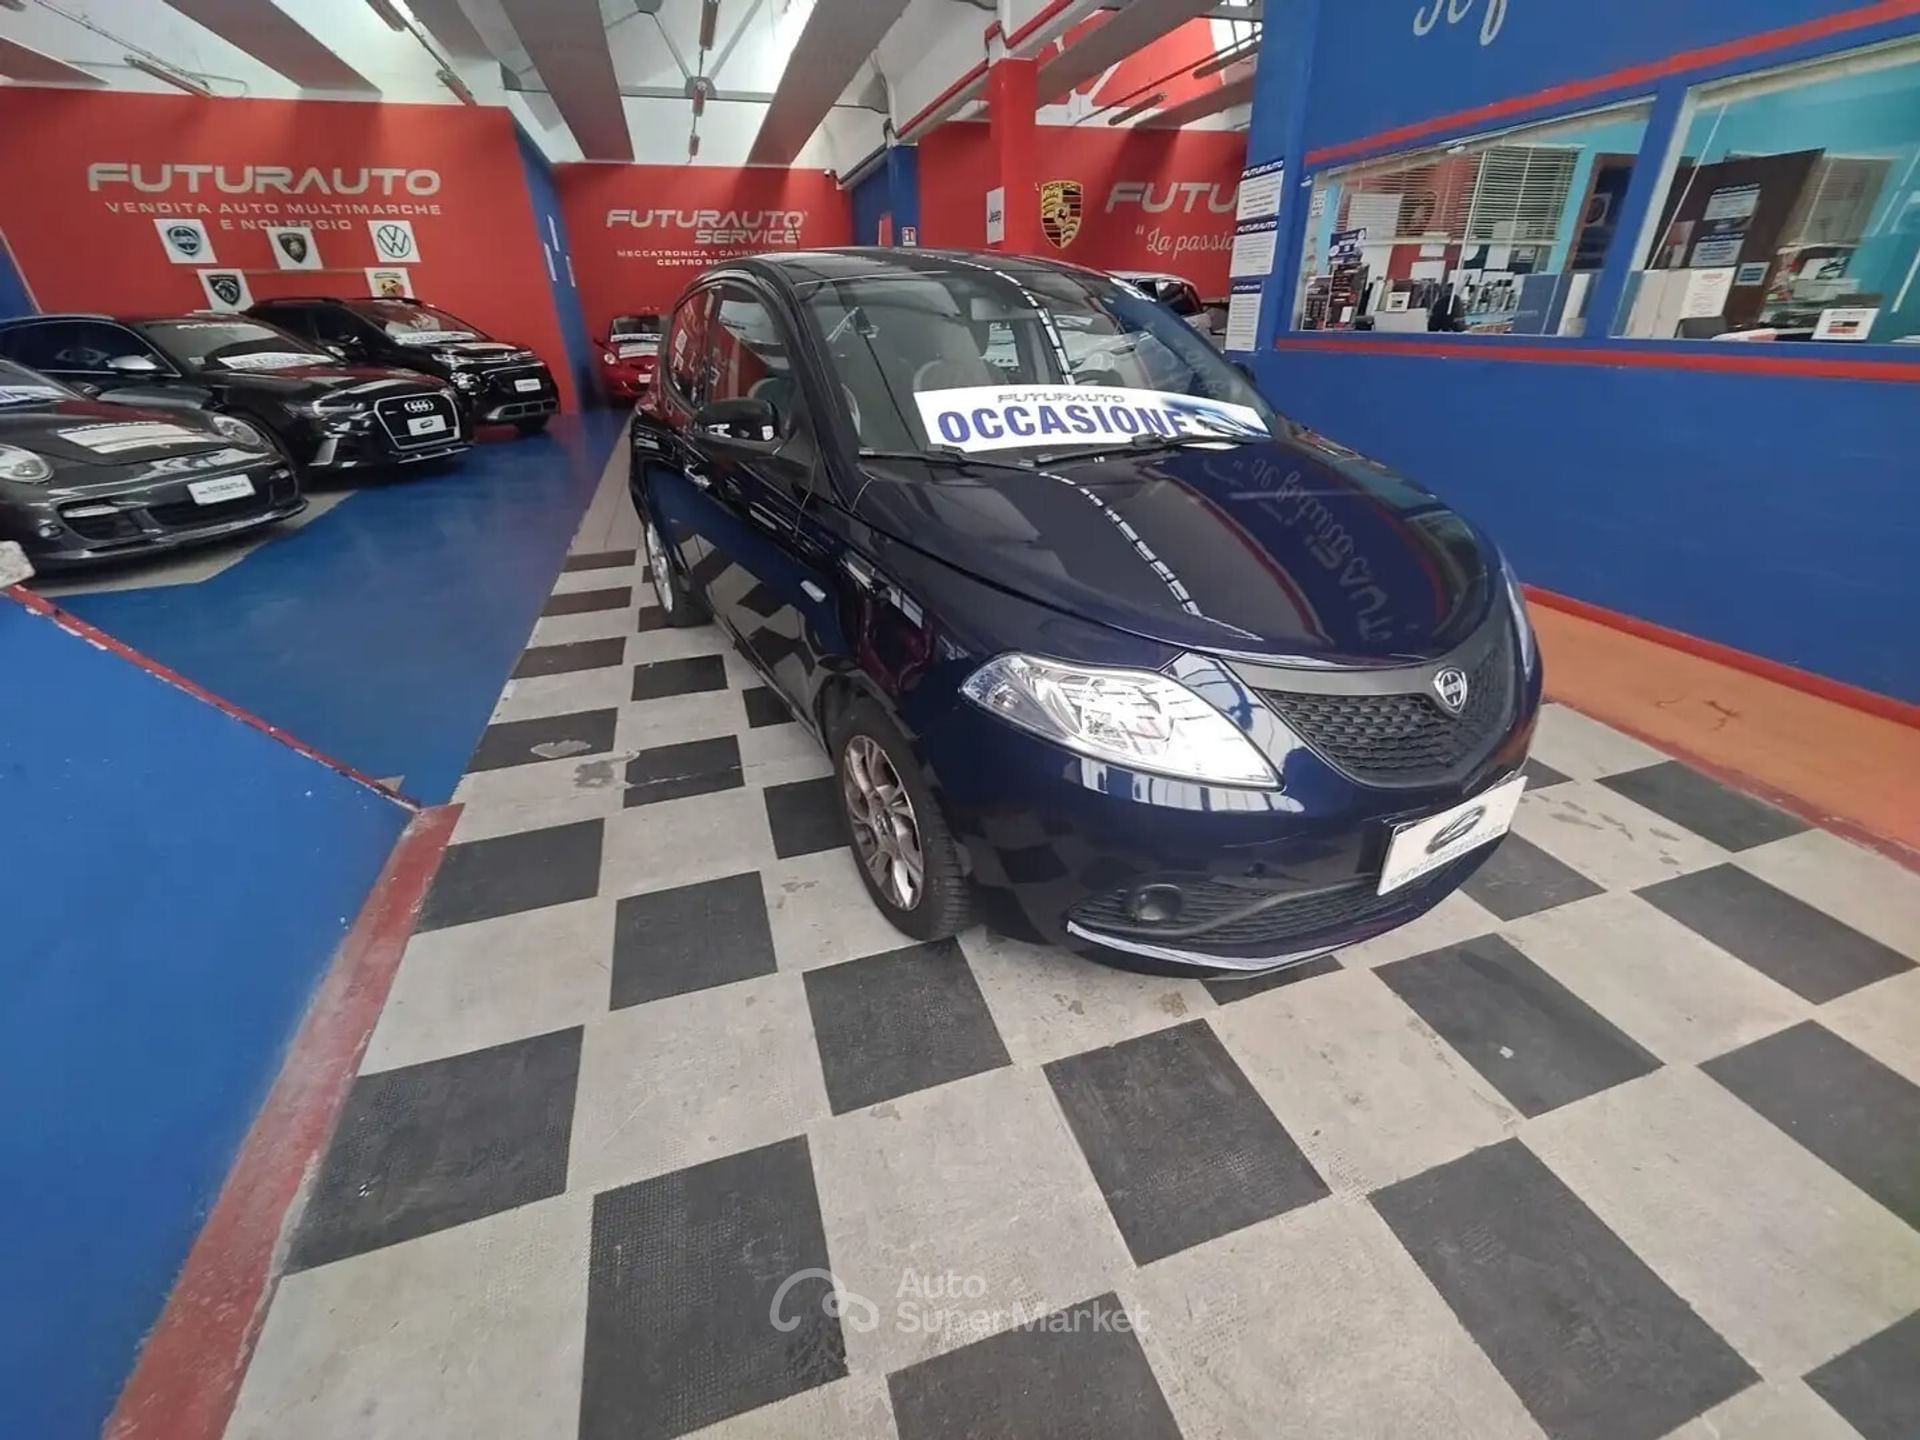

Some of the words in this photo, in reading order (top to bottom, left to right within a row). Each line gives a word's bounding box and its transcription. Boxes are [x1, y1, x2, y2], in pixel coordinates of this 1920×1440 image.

[87, 162, 441, 196] FUTURAUTO
[105, 202, 211, 214] VENDITA
[219, 203, 279, 214] AUTO
[287, 203, 441, 215] MULTIMARCHE
[220, 219, 233, 230] E
[241, 219, 352, 231] NOLEGGIO
[606, 209, 804, 229] FUTURAUTO
[695, 229, 801, 245] SERVICE
[657, 258, 703, 267] CENTRO
[996, 393, 1126, 404] FUTURAUTO
[937, 404, 1190, 444] OCCASIONE
